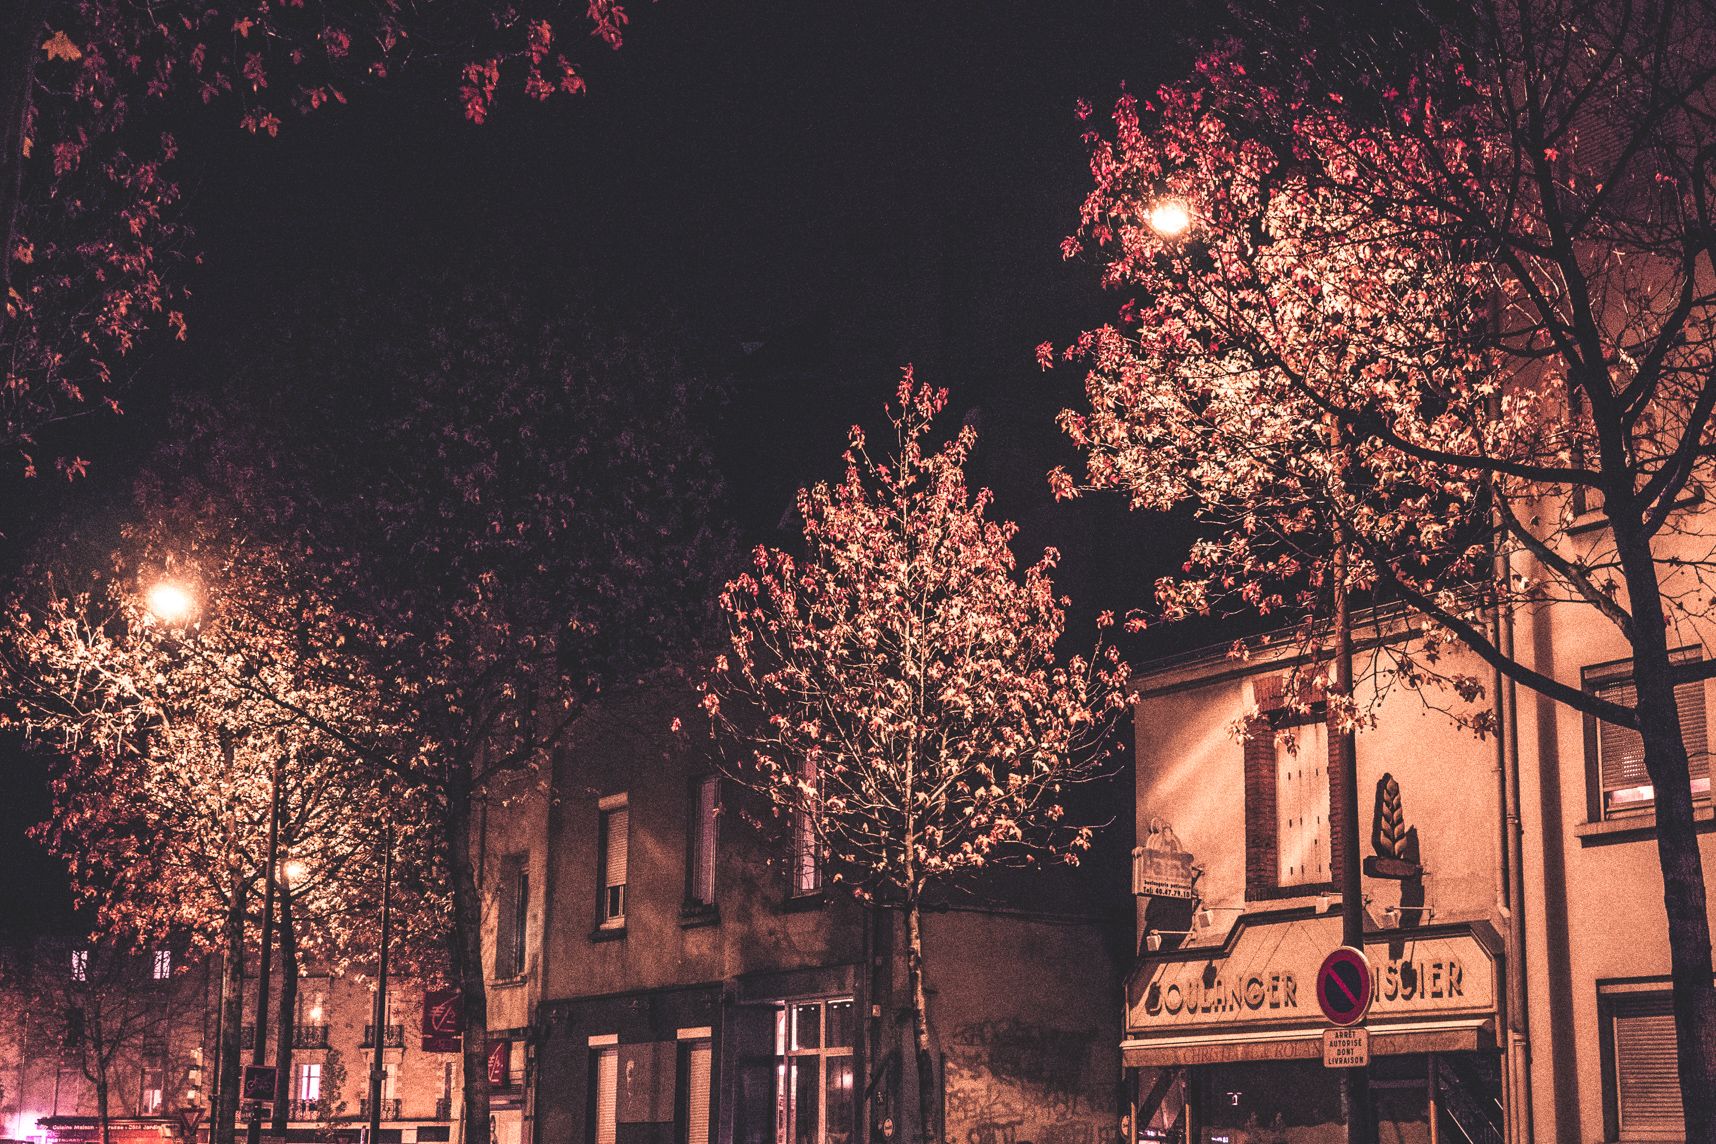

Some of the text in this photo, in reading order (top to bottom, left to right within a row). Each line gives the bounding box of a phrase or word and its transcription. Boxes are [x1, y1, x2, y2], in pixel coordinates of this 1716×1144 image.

[1328, 1038, 1362, 1048] AUTORISÉ
[1336, 1048, 1354, 1056] DONT
[1327, 1056, 1364, 1065] LIVRAISON
